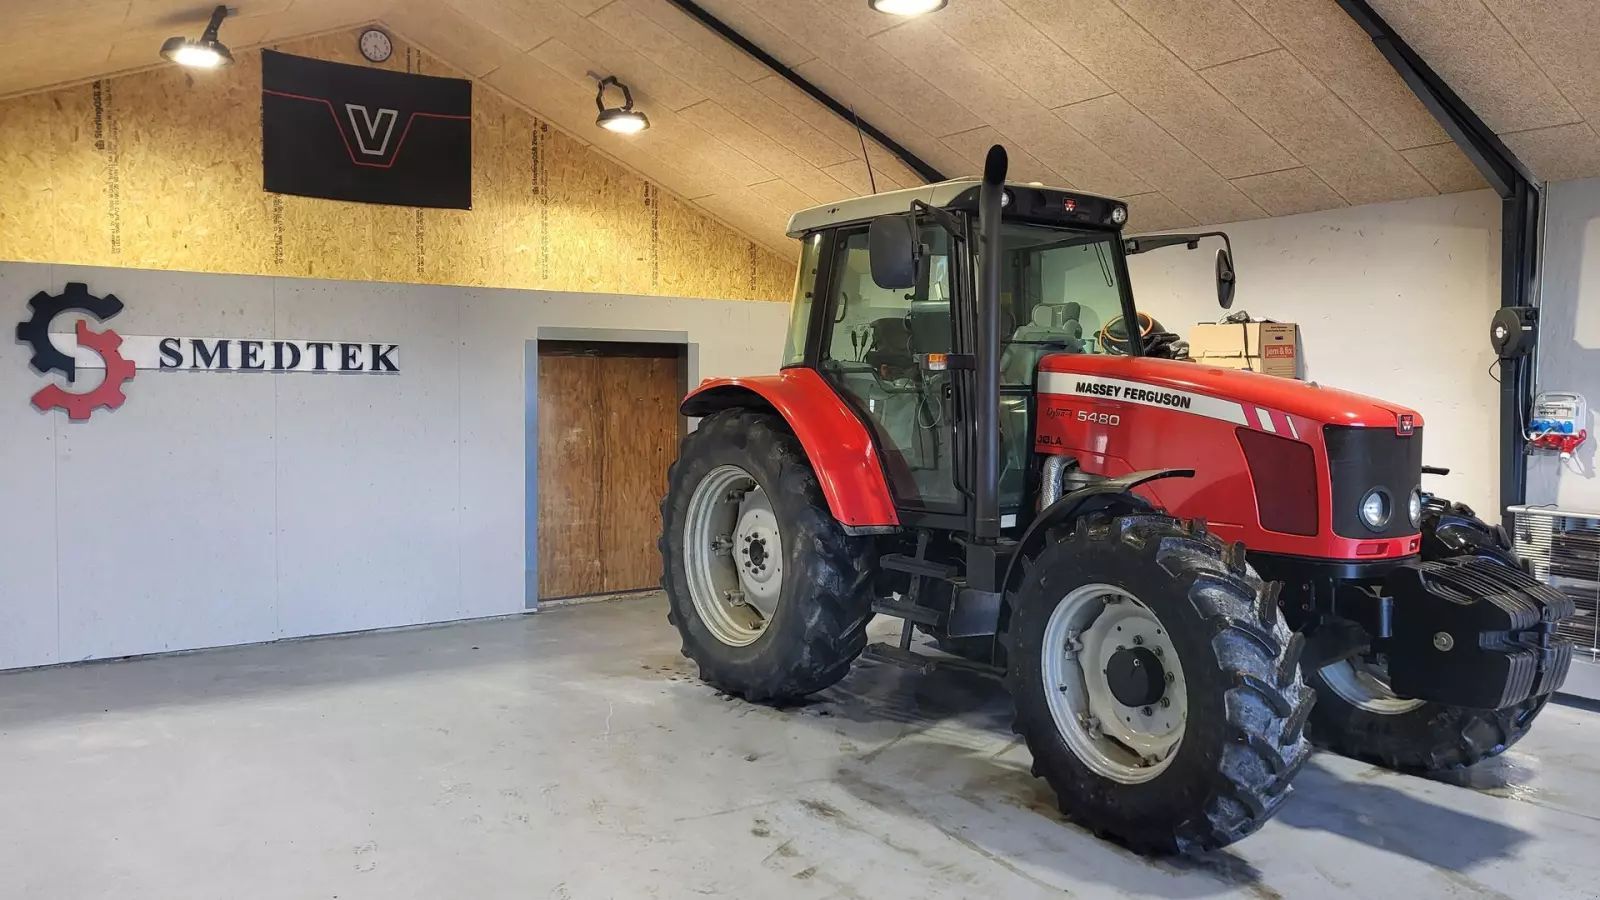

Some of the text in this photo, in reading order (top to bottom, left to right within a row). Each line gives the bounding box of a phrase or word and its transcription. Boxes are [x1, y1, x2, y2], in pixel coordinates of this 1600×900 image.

[158, 337, 400, 372] SMEDTEK
[1075, 381, 1191, 409] MASSEY FERGUSON
[1077, 410, 1120, 426] 5480
